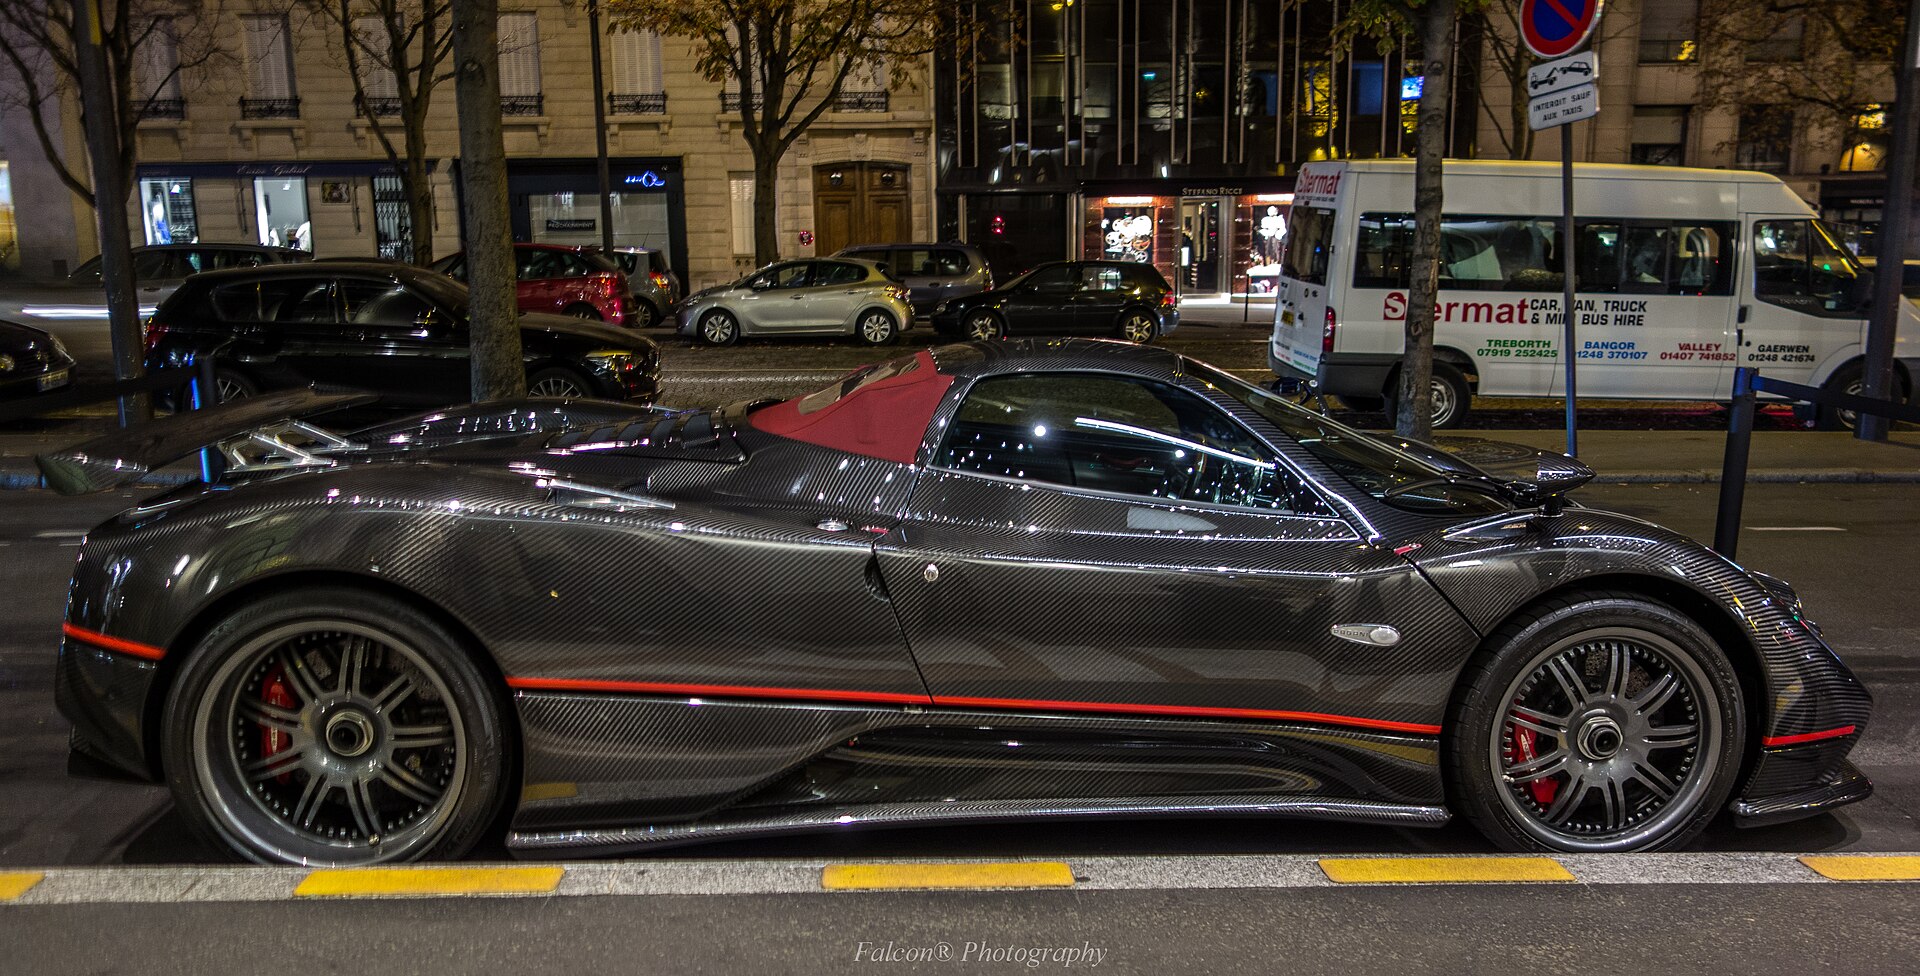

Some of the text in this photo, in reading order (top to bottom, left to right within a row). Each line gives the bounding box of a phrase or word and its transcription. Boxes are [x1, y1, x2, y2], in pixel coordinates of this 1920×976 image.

[1533, 90, 1591, 112] INTERDIT SAUF
[1543, 105, 1583, 121] AUX TAXIS
[1182, 186, 1243, 196] STEFANO RICCI
[1383, 291, 1529, 324] Sermat
[1530, 298, 1647, 312] CAR, AN, TRUCK
[1531, 312, 1540, 324] &
[1581, 313, 1608, 325] BUS
[1614, 314, 1644, 326] HIRE
[1486, 339, 1551, 348] TREBORTH
[1584, 341, 1636, 350] BANGOR
[1678, 343, 1721, 351] VALLEY
[1476, 348, 1557, 357] 07919 252425
[1758, 344, 1810, 353] GAERWEN
[1574, 350, 1648, 359] 1248 370107
[1660, 351, 1736, 361] 01407 741852
[1748, 353, 1815, 362] 01248 421674
[1333, 629, 1369, 638] PAGANI
